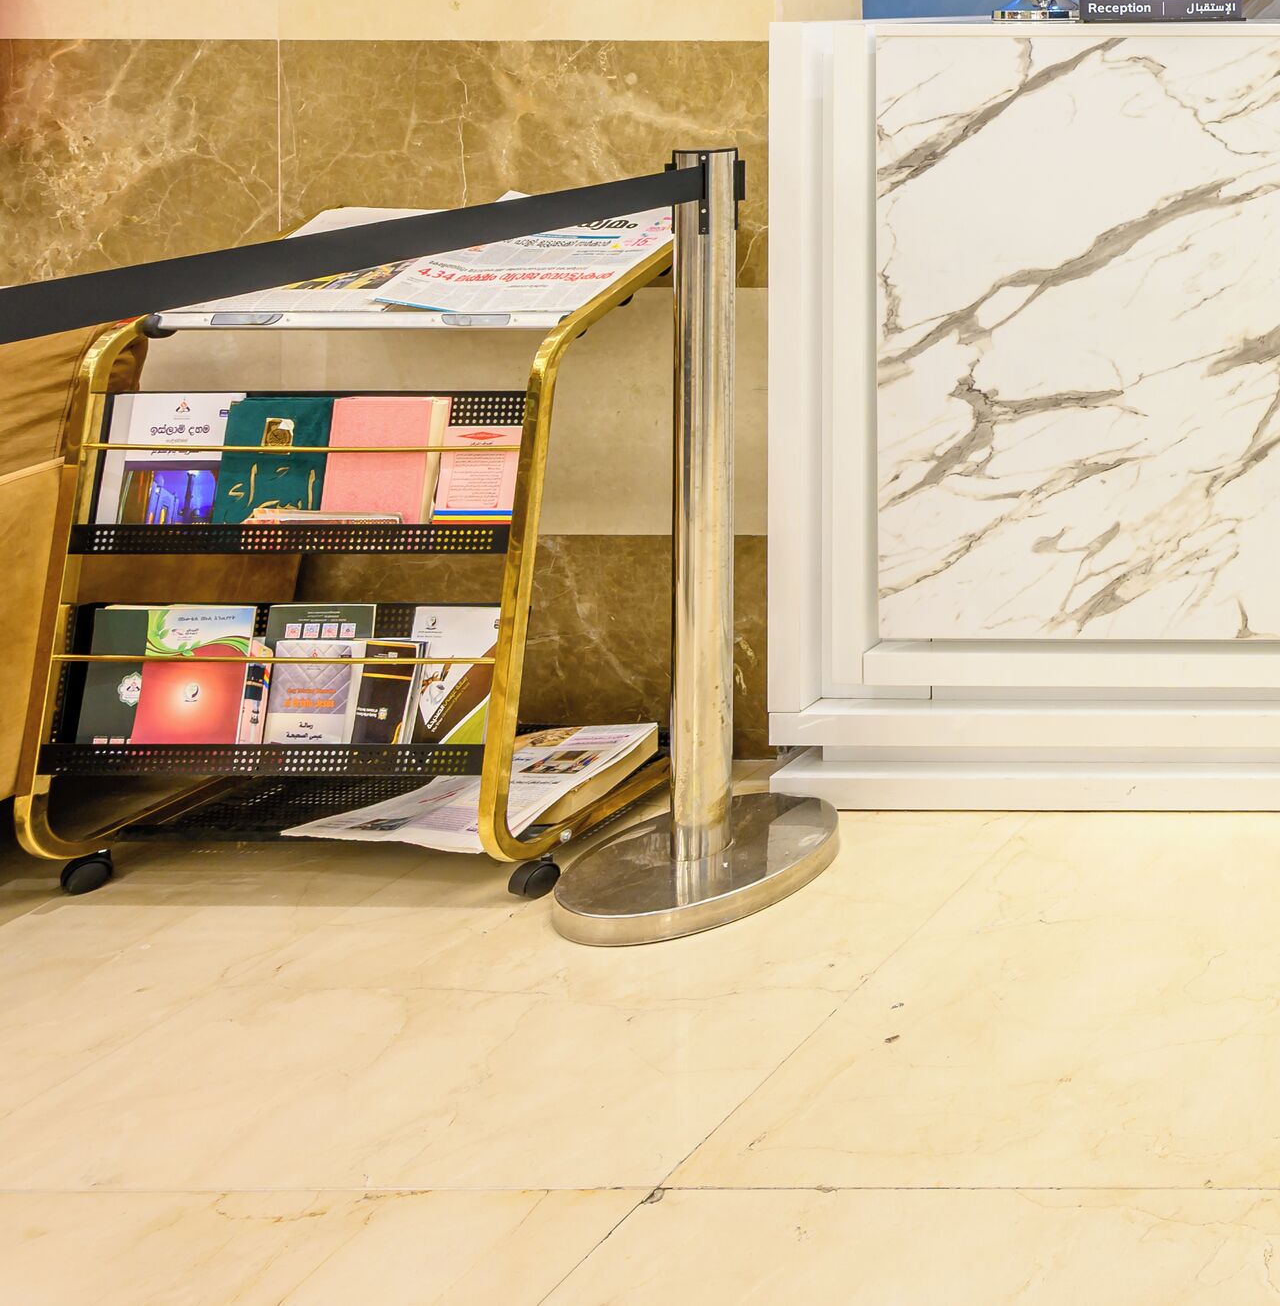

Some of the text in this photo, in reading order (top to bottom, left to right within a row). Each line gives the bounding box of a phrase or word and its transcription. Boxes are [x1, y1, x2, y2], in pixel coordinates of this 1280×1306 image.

[1088, 2, 1151, 16] Reception
[1186, 2, 1236, 15] الإستقبال
[418, 267, 455, 281] 4.34
